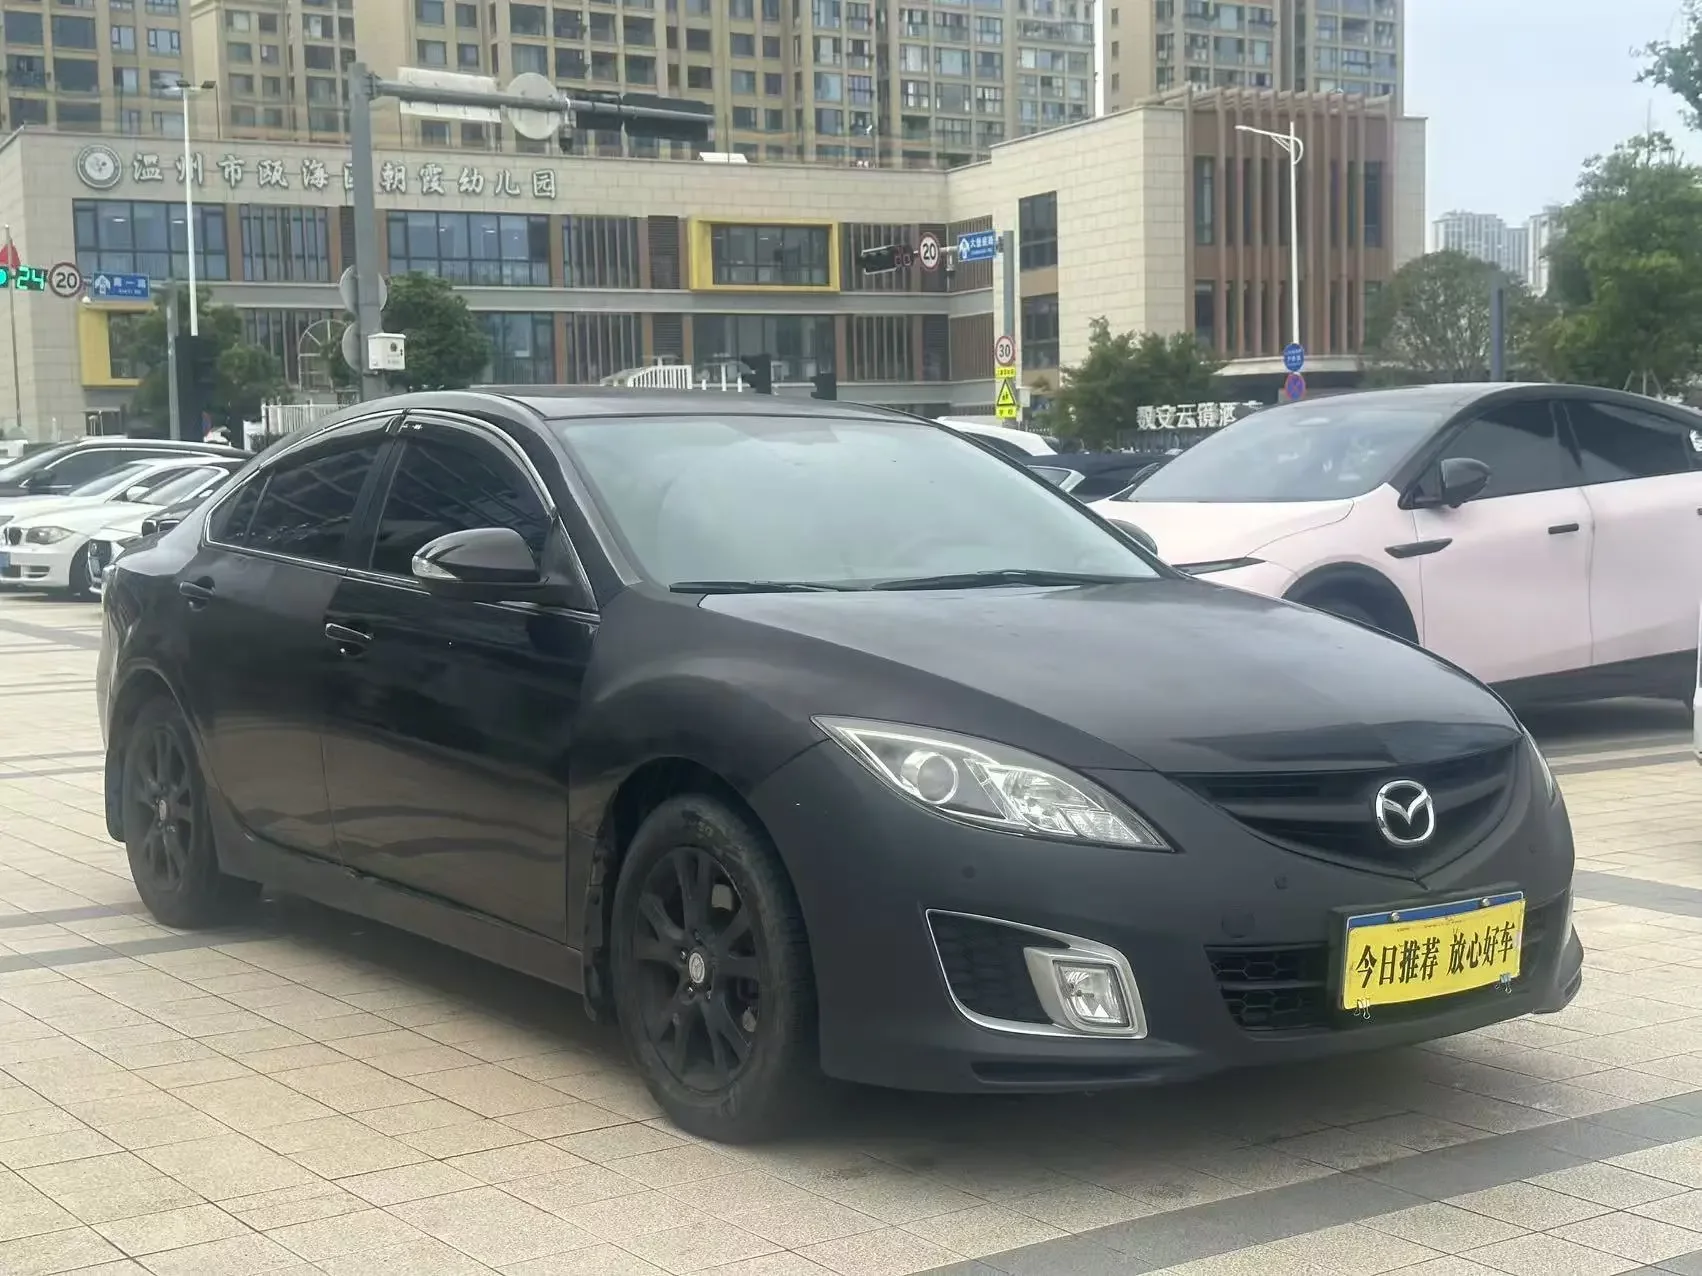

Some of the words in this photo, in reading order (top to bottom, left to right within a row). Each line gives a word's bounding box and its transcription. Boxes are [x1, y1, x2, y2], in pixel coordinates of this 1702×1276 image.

[922, 243, 937, 260] 20
[16, 266, 45, 290] 24
[55, 272, 78, 289] 20
[999, 344, 1011, 358] 30
[1136, 400, 1263, 431] 安云镜酒
[1355, 936, 1441, 989] 今日推荐
[1446, 920, 1516, 976] 放心好车
